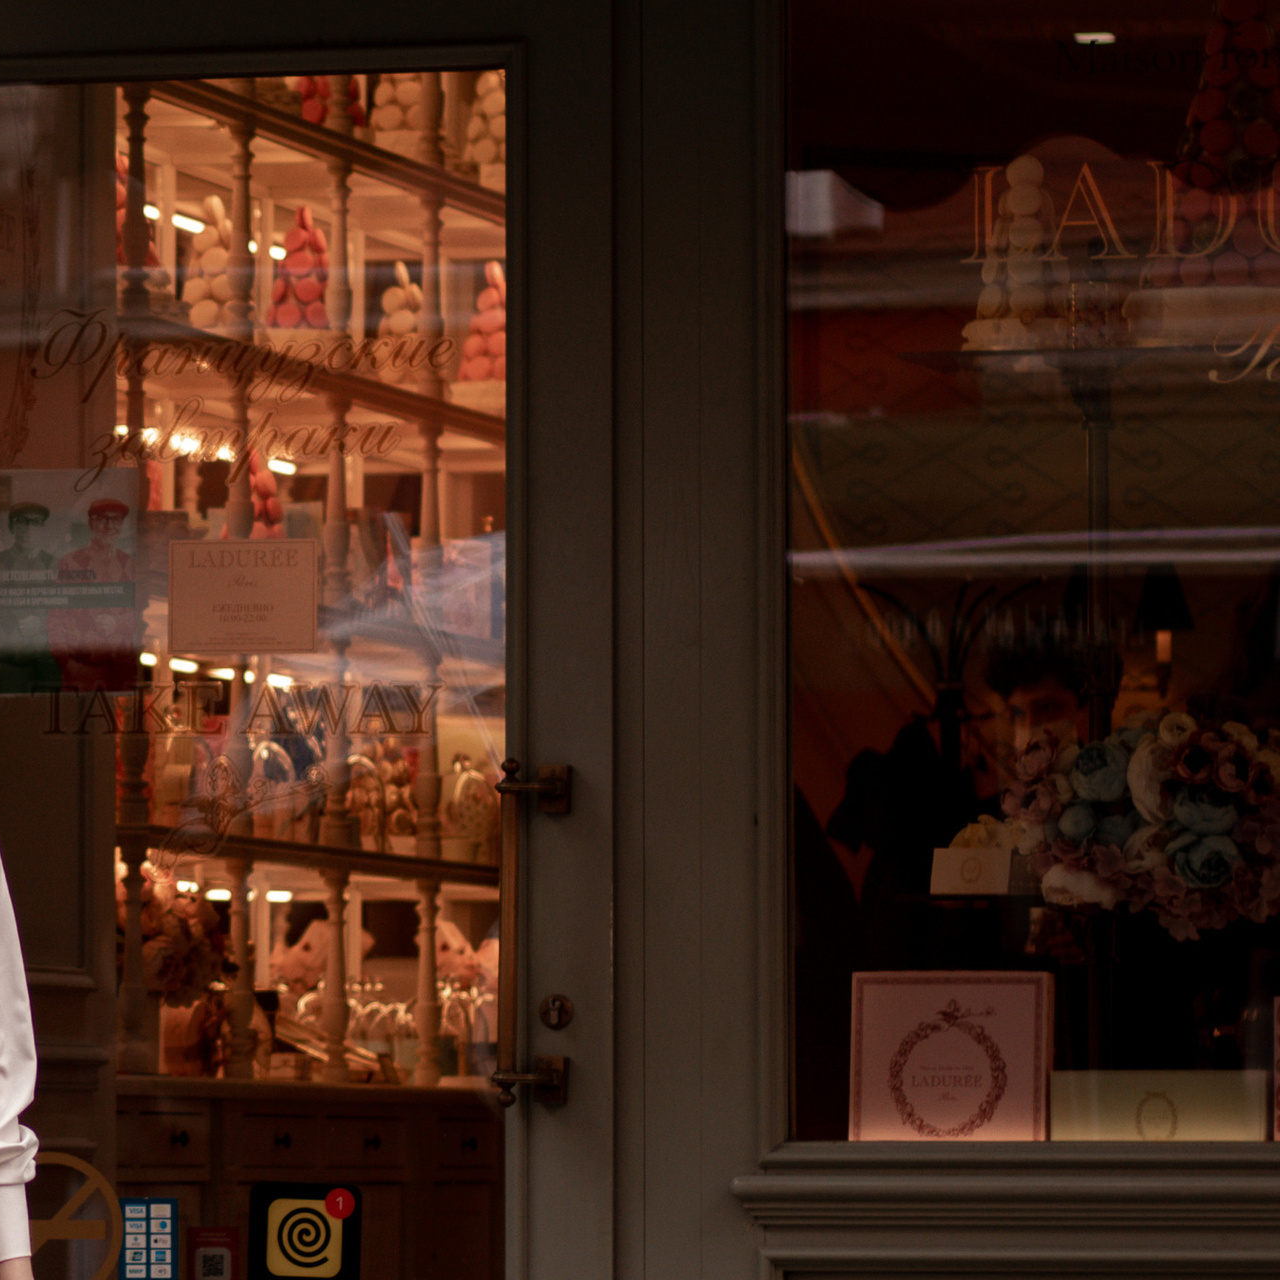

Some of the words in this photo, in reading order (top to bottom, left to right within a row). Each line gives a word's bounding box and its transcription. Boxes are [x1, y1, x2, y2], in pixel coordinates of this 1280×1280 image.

[30, 307, 457, 405] Французские
[74, 395, 402, 493] завтраки
[188, 547, 299, 569] LADURÉE
[31, 681, 228, 736] TAKE
[239, 681, 444, 736] AWAY
[128, 1207, 144, 1215] VISA
